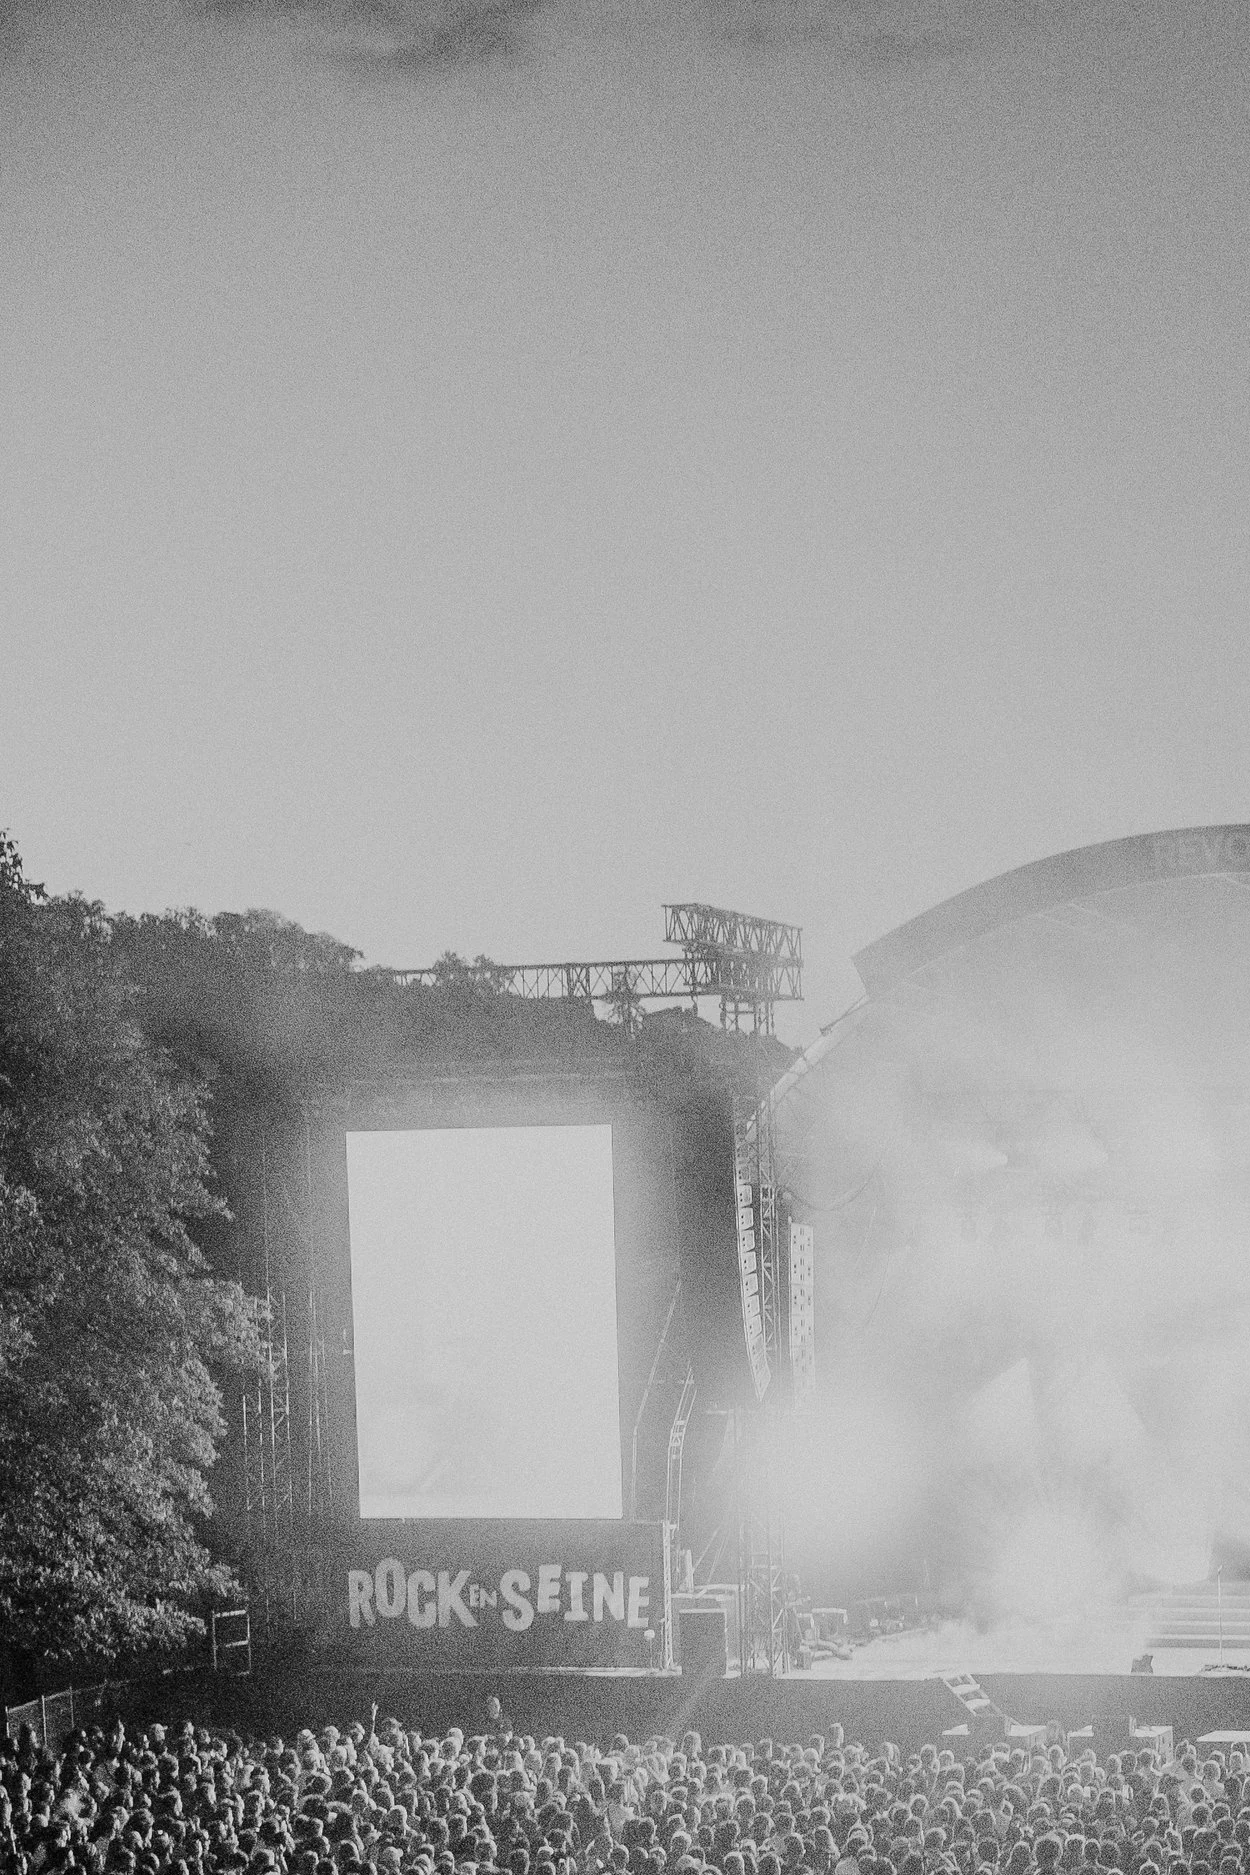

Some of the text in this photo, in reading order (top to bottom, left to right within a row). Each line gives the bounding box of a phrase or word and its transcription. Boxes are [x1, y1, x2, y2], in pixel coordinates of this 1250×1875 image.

[348, 1557, 650, 1632] ROCK EN SEINE
